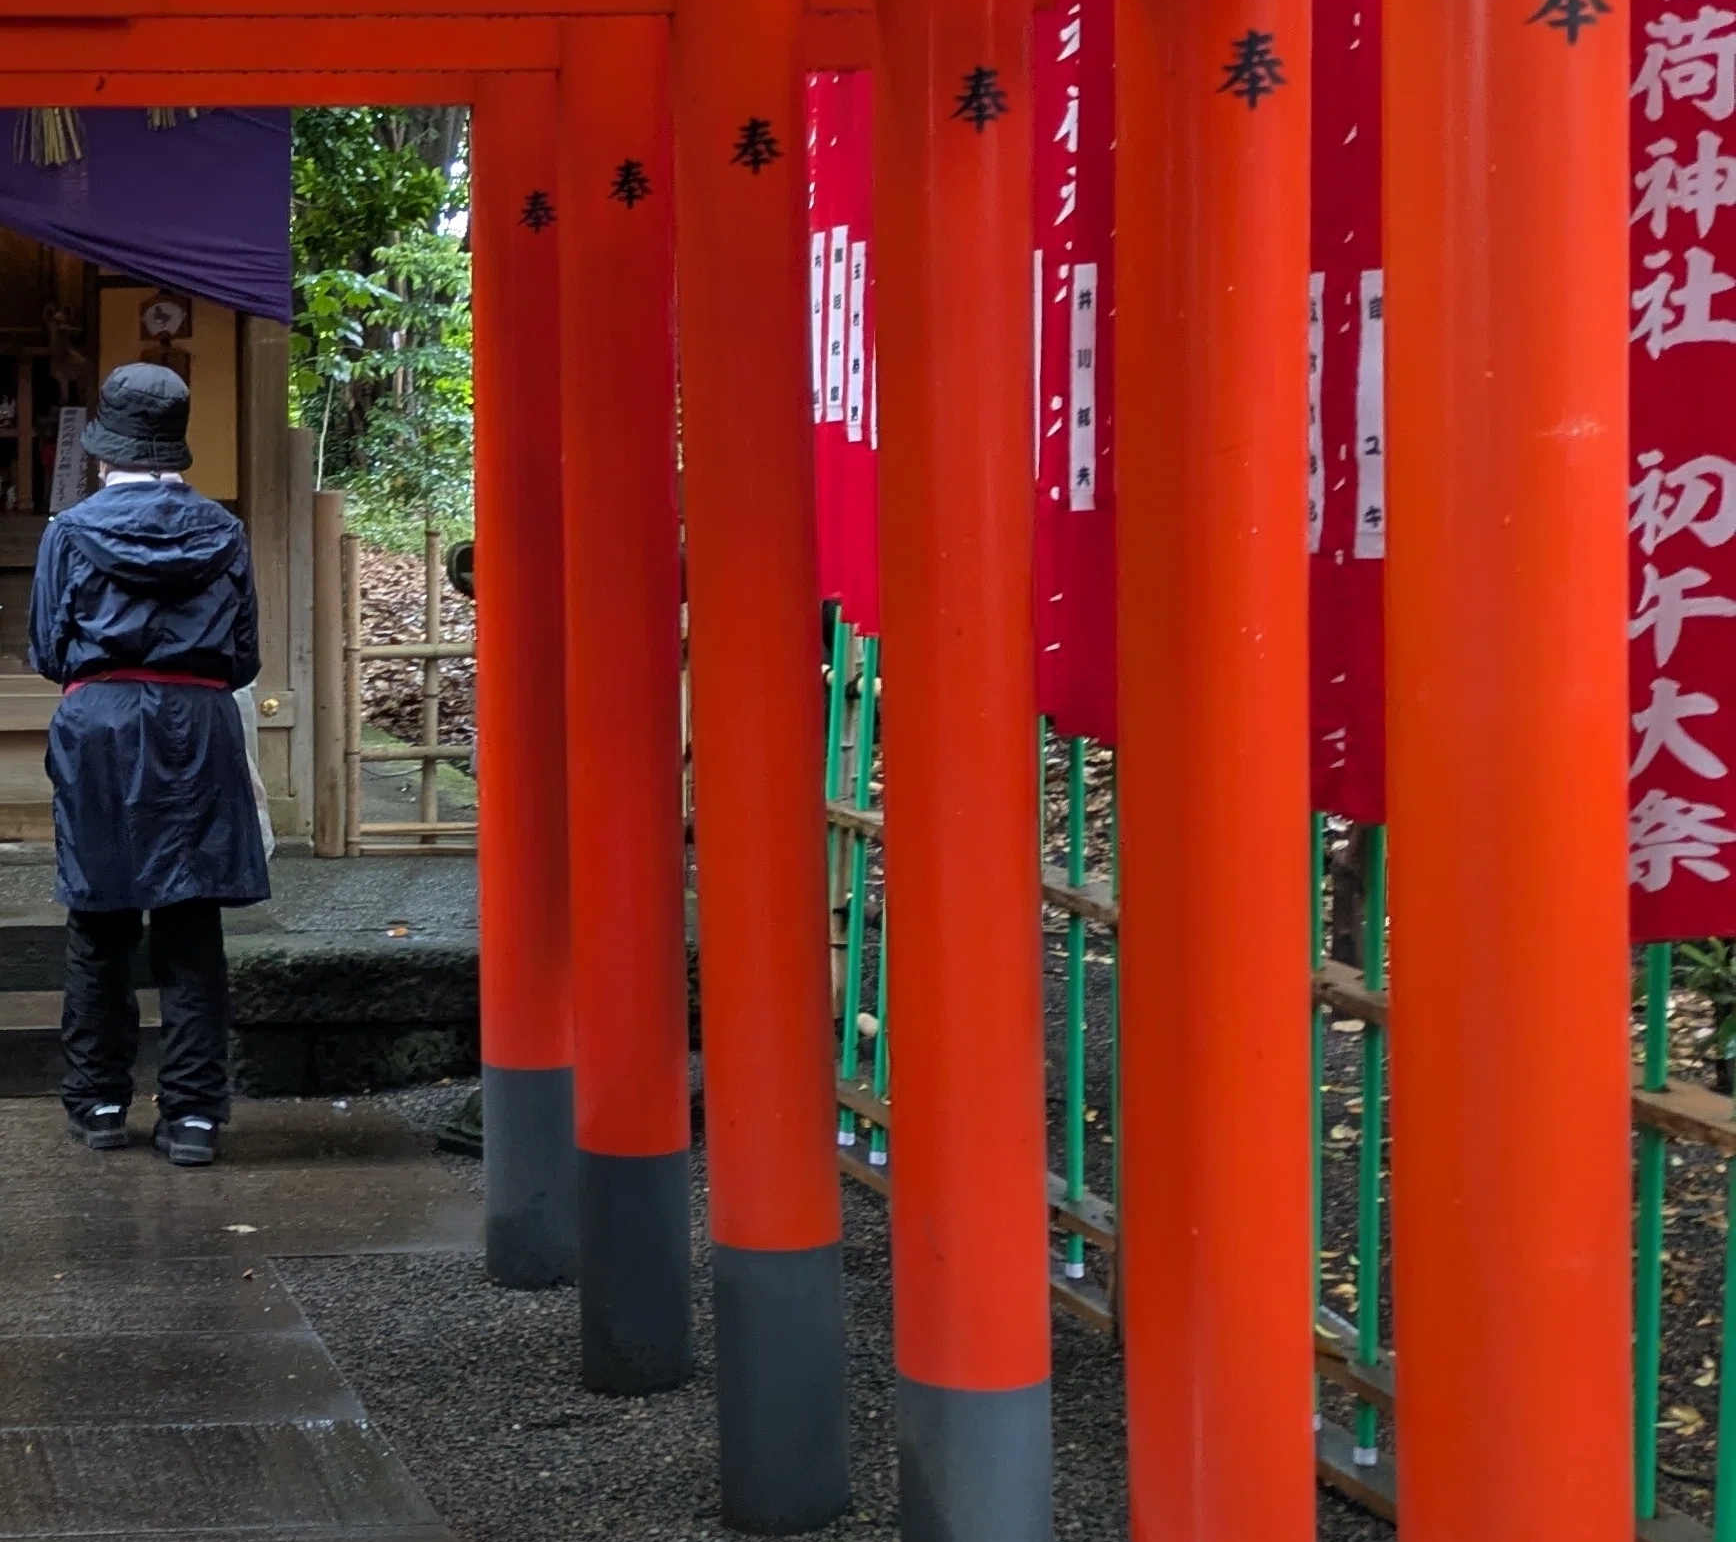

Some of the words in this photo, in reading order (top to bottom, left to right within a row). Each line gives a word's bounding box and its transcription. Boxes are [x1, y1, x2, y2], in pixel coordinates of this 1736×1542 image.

[949, 65, 1011, 135] 奉
[1215, 28, 1287, 111] 奉
[729, 115, 784, 176] 奉
[516, 189, 558, 236] 奉
[606, 157, 655, 210] 奉
[1628, 451, 1736, 895] 初午大祭
